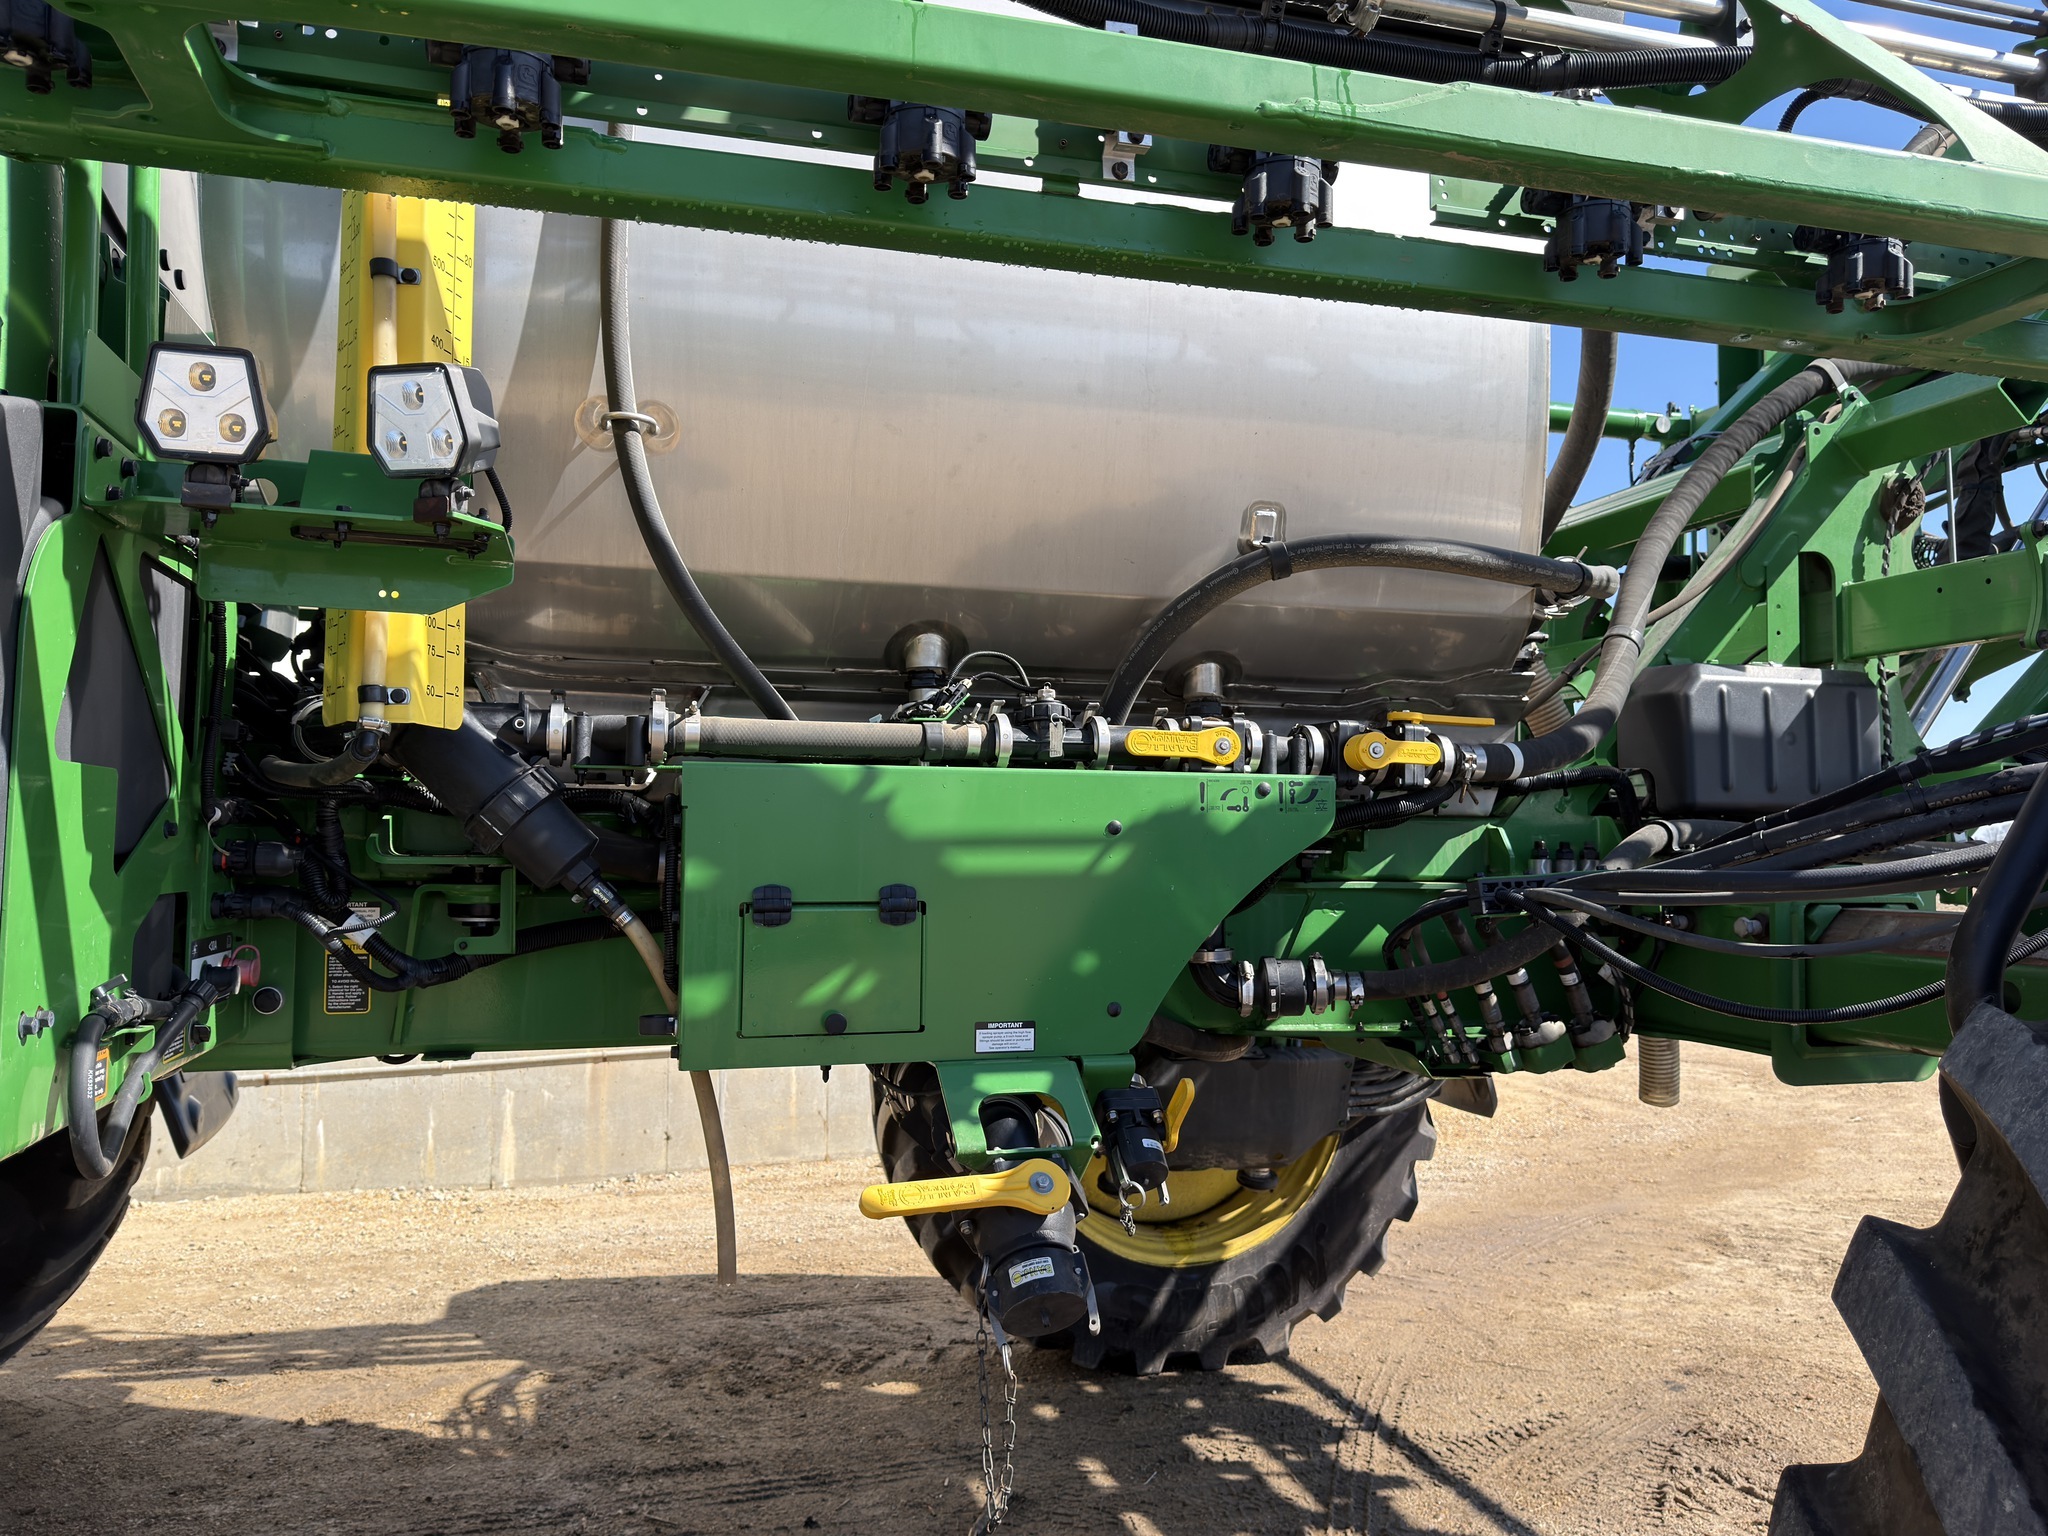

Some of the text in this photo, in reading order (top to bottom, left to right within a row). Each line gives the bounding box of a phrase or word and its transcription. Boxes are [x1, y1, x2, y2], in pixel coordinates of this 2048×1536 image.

[432, 255, 446, 272] 500
[464, 254, 473, 269] 20
[431, 334, 444, 350] 400
[1209, 567, 1239, 588] Continental
[1177, 590, 1201, 610] FRONTIER
[455, 618, 461, 630] 4
[427, 644, 436, 656] 75
[455, 644, 461, 656] 3
[426, 685, 435, 697] 50
[454, 686, 460, 698] 2
